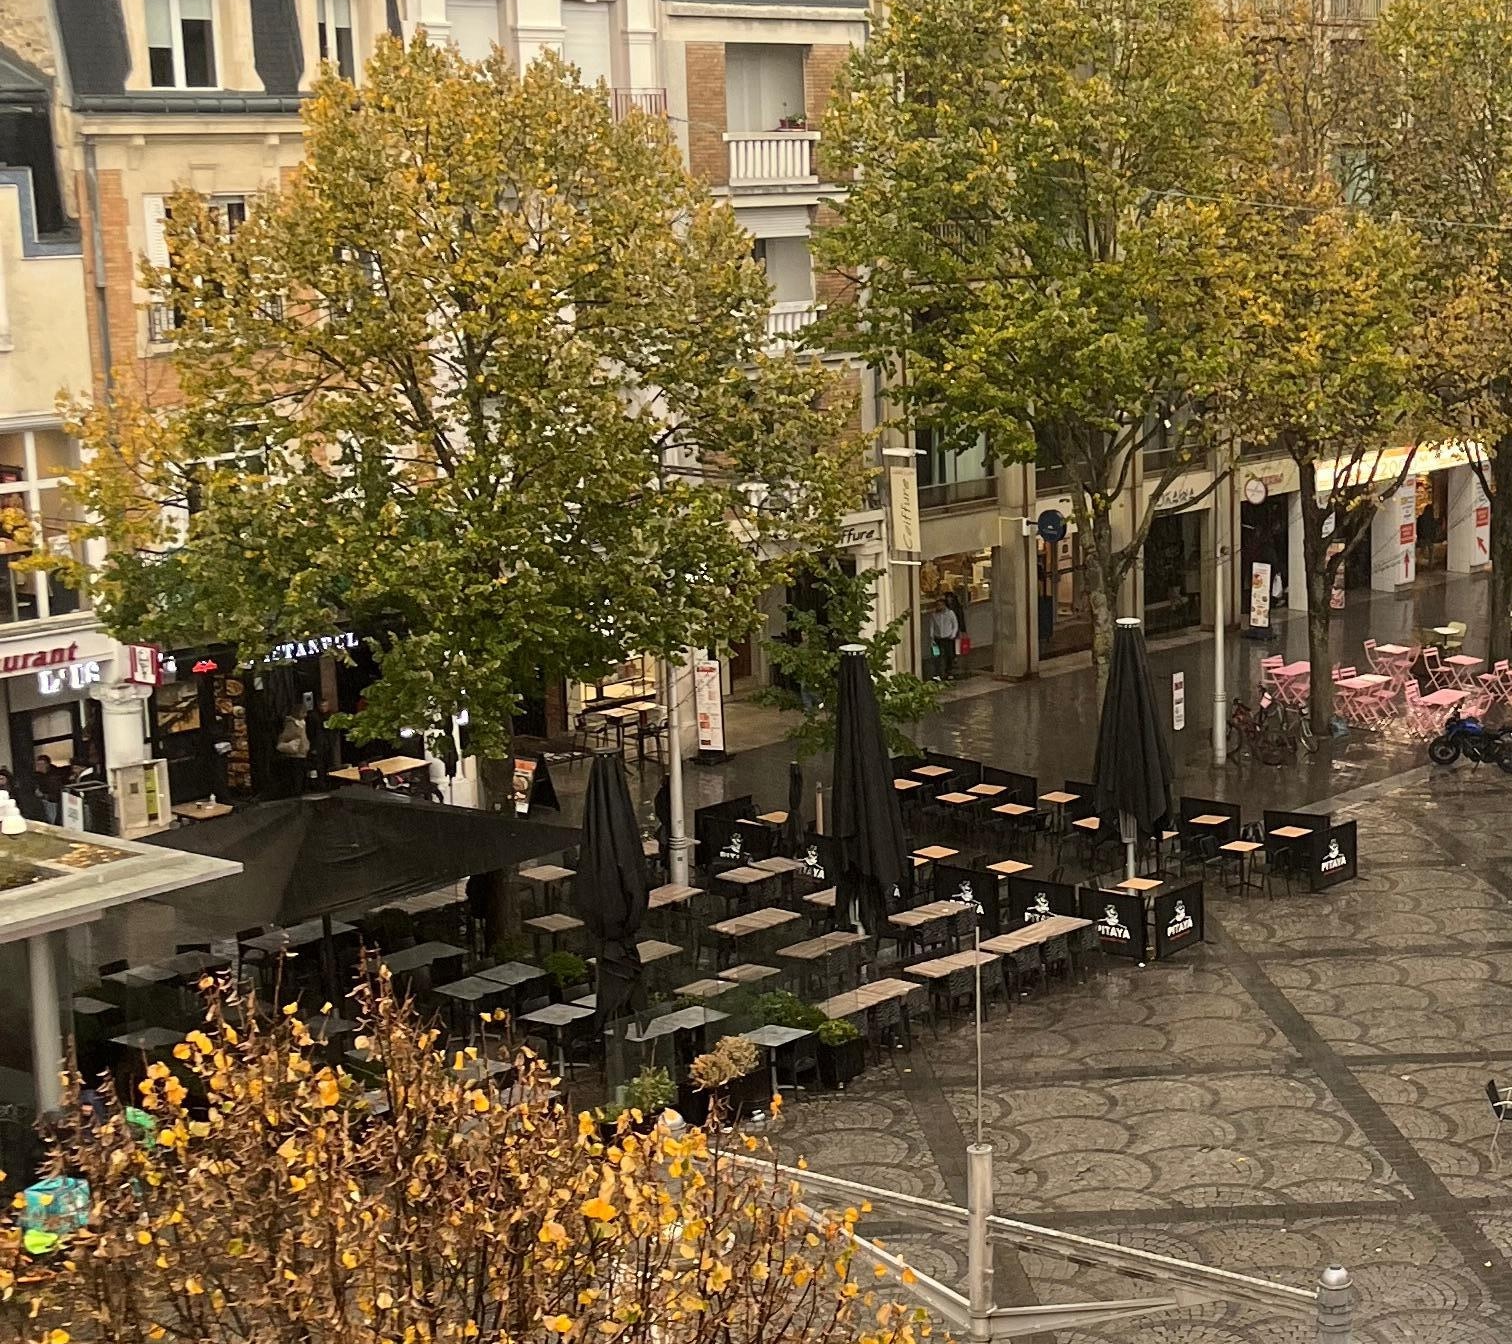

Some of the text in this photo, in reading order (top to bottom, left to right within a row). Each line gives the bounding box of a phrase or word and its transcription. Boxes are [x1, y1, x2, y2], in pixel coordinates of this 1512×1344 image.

[2, 641, 78, 673] urant
[1321, 856, 1347, 873] PITAYA
[1164, 917, 1194, 937] PITAYA
